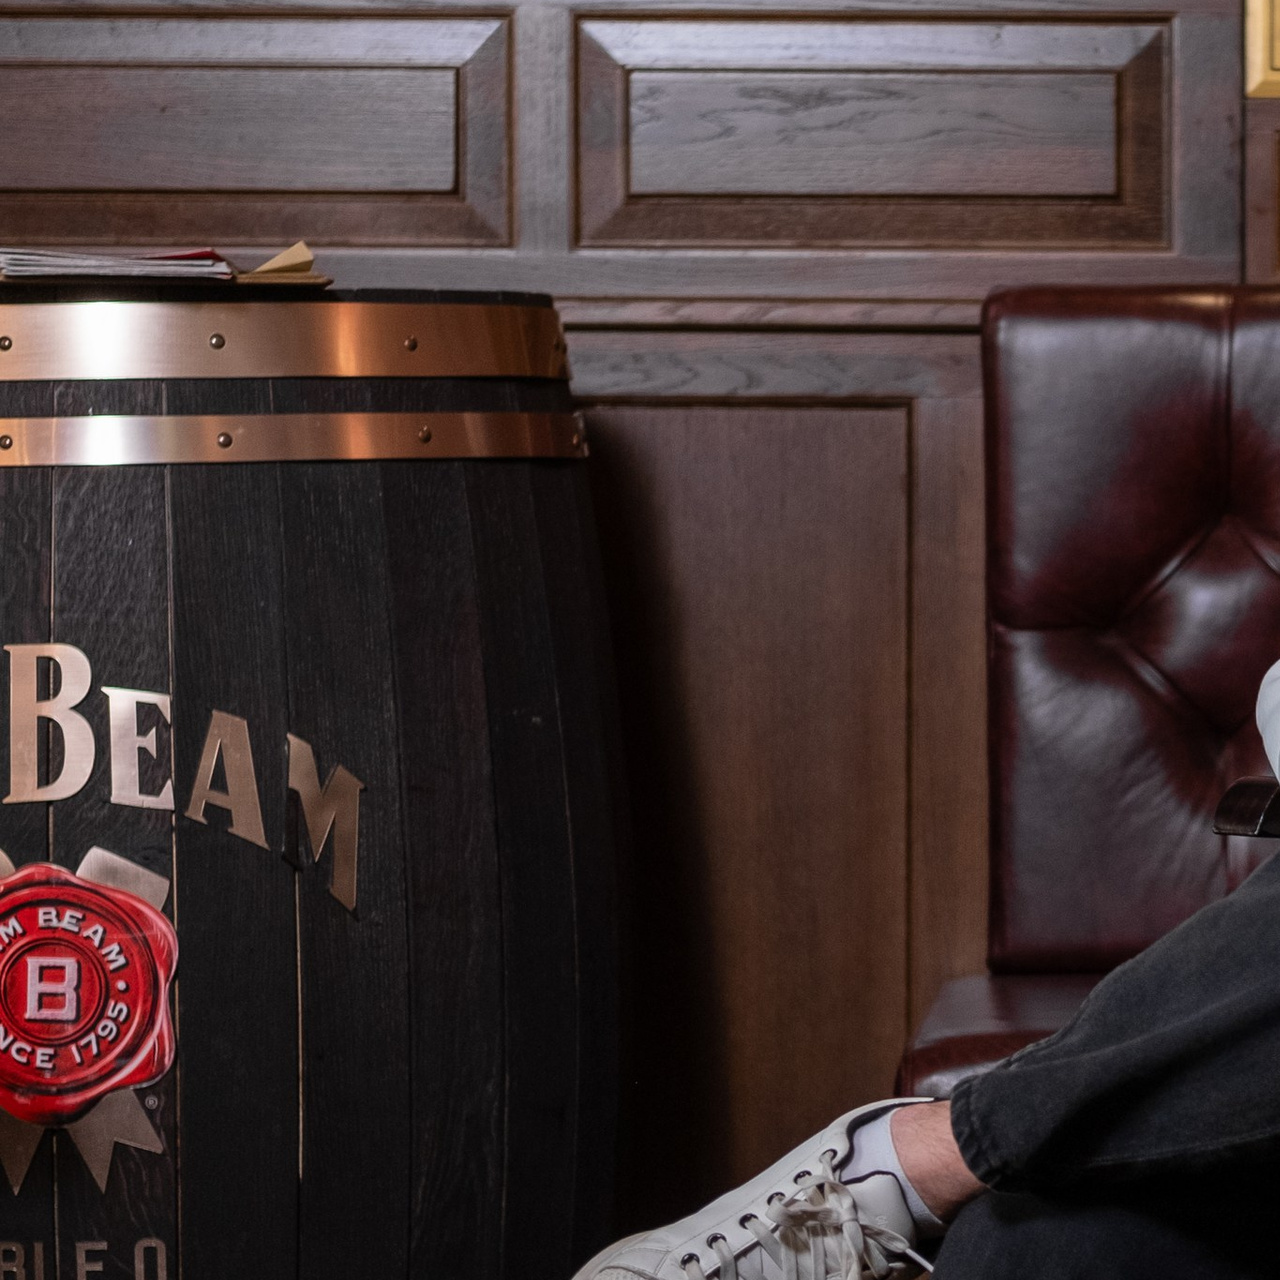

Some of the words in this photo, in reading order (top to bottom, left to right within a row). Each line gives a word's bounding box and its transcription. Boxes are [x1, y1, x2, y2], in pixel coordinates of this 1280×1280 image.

[2, 642, 365, 912] BEAM
[38, 907, 127, 971] BEAM
[25, 957, 80, 1021] B
[71, 999, 128, 1064] 1795
